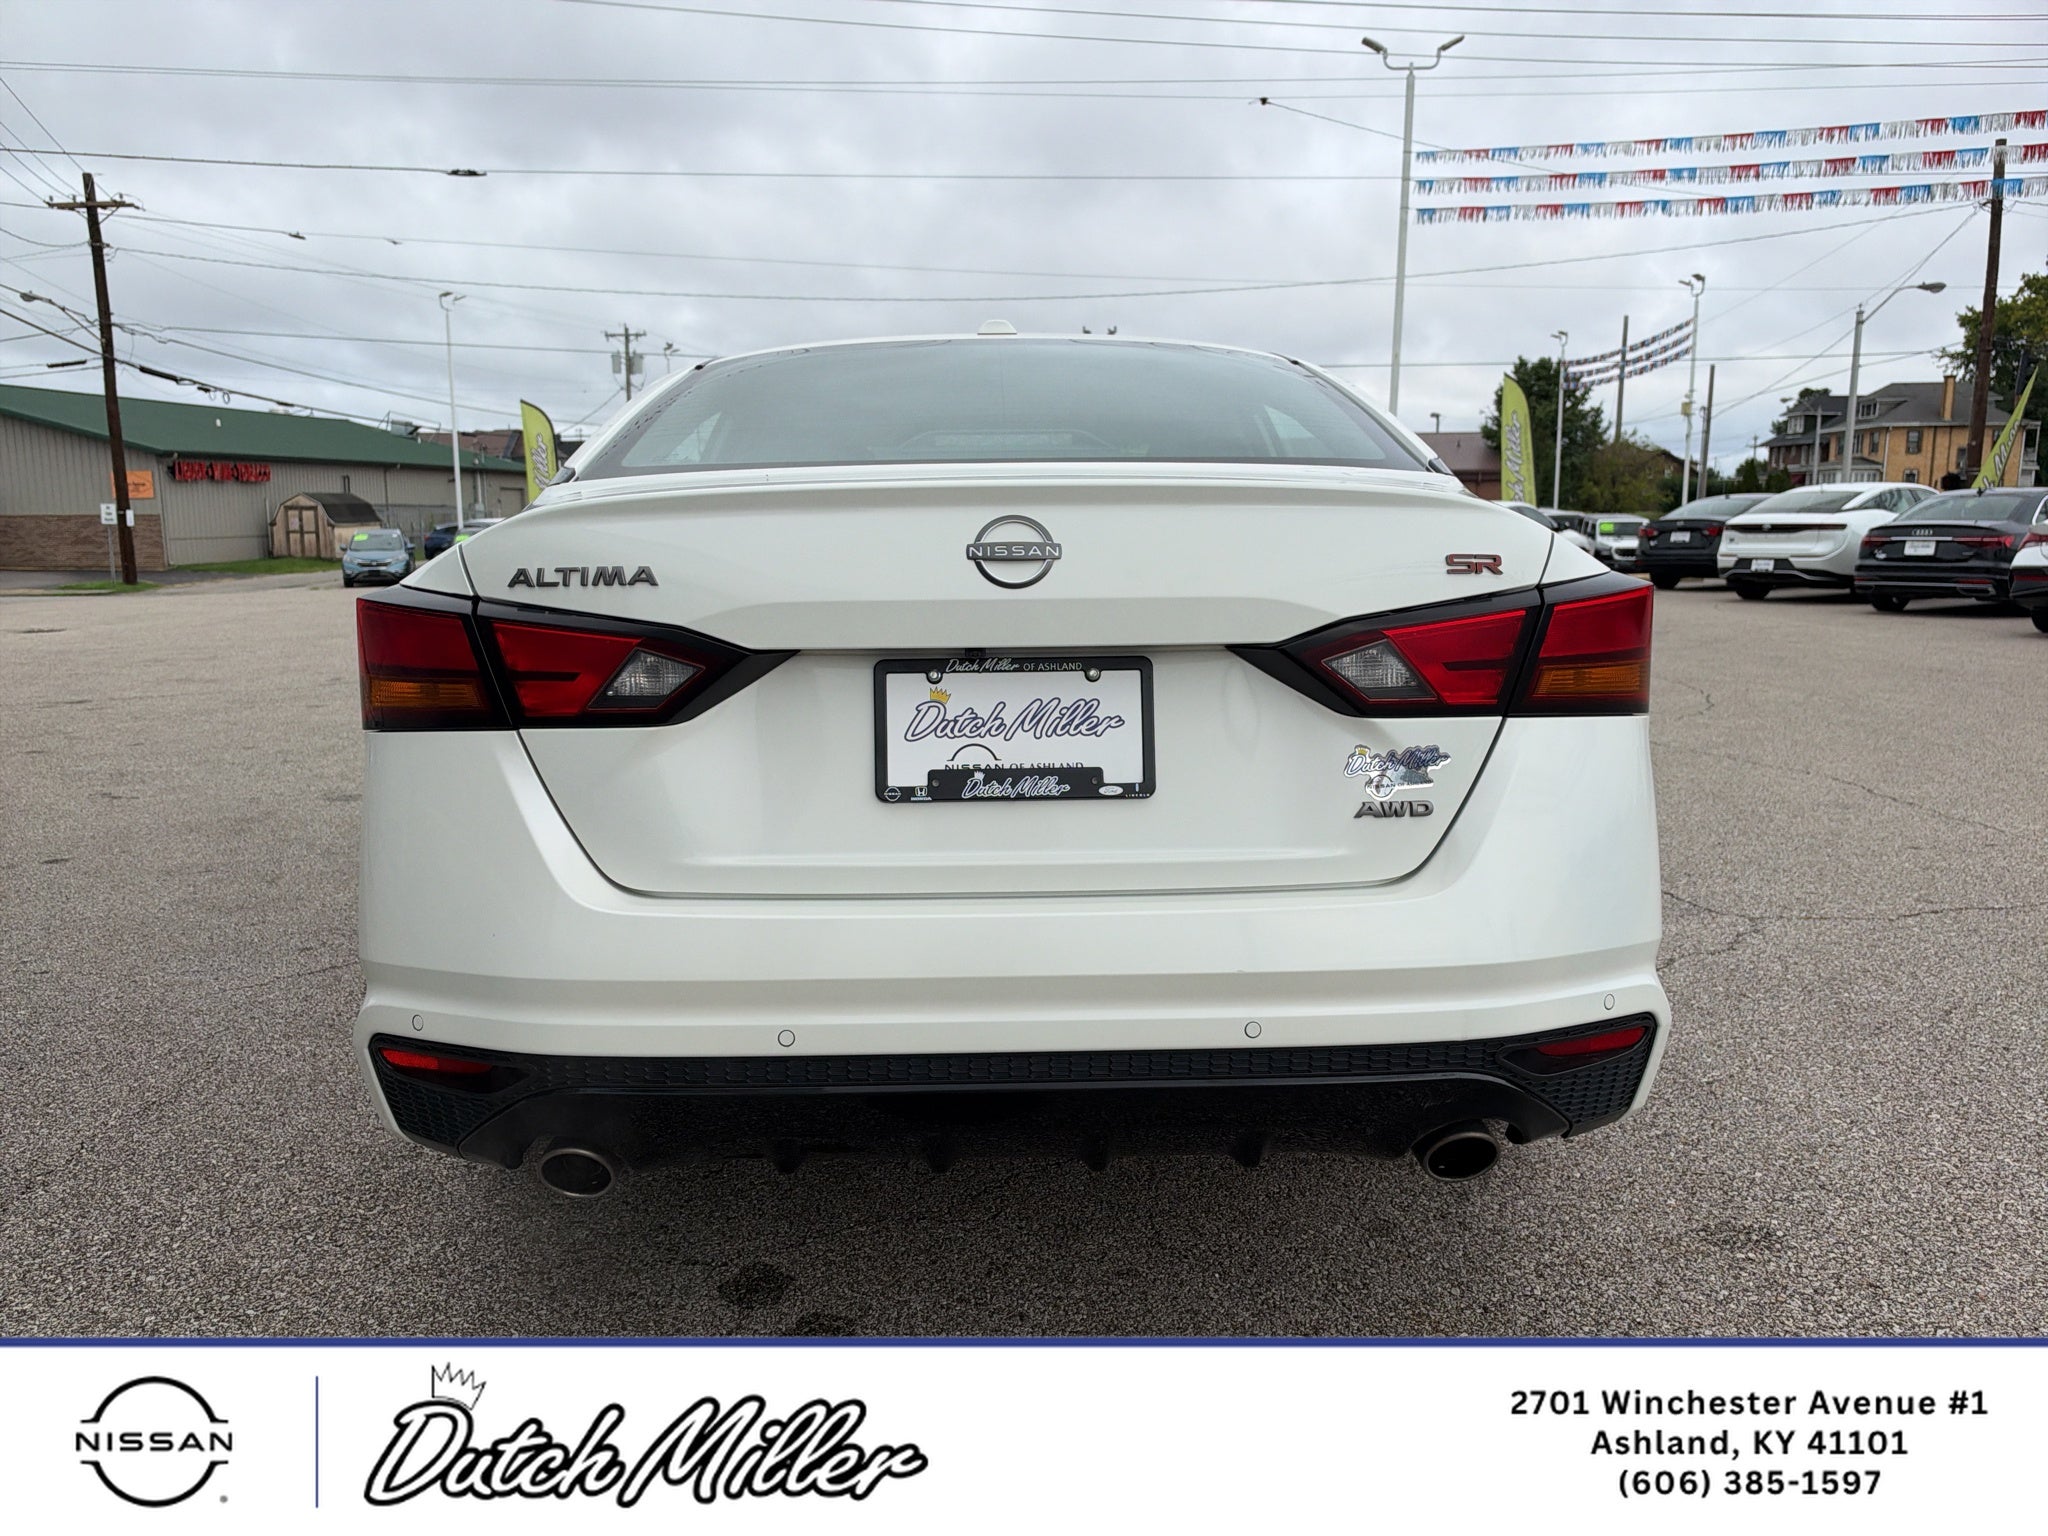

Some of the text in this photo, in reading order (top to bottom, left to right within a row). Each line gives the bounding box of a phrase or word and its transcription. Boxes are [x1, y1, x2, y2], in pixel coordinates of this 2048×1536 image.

[969, 545, 1059, 557] NISSAN
[1445, 553, 1503, 576] SR
[507, 565, 659, 588] ALTIMA
[946, 657, 1083, 673] Dutch Miller OF ASHLAND
[904, 697, 1125, 742] Dutch Miller
[1346, 750, 1395, 775] Dutch
[961, 775, 1071, 799] Dutch Miller
[1353, 800, 1434, 818] AWD
